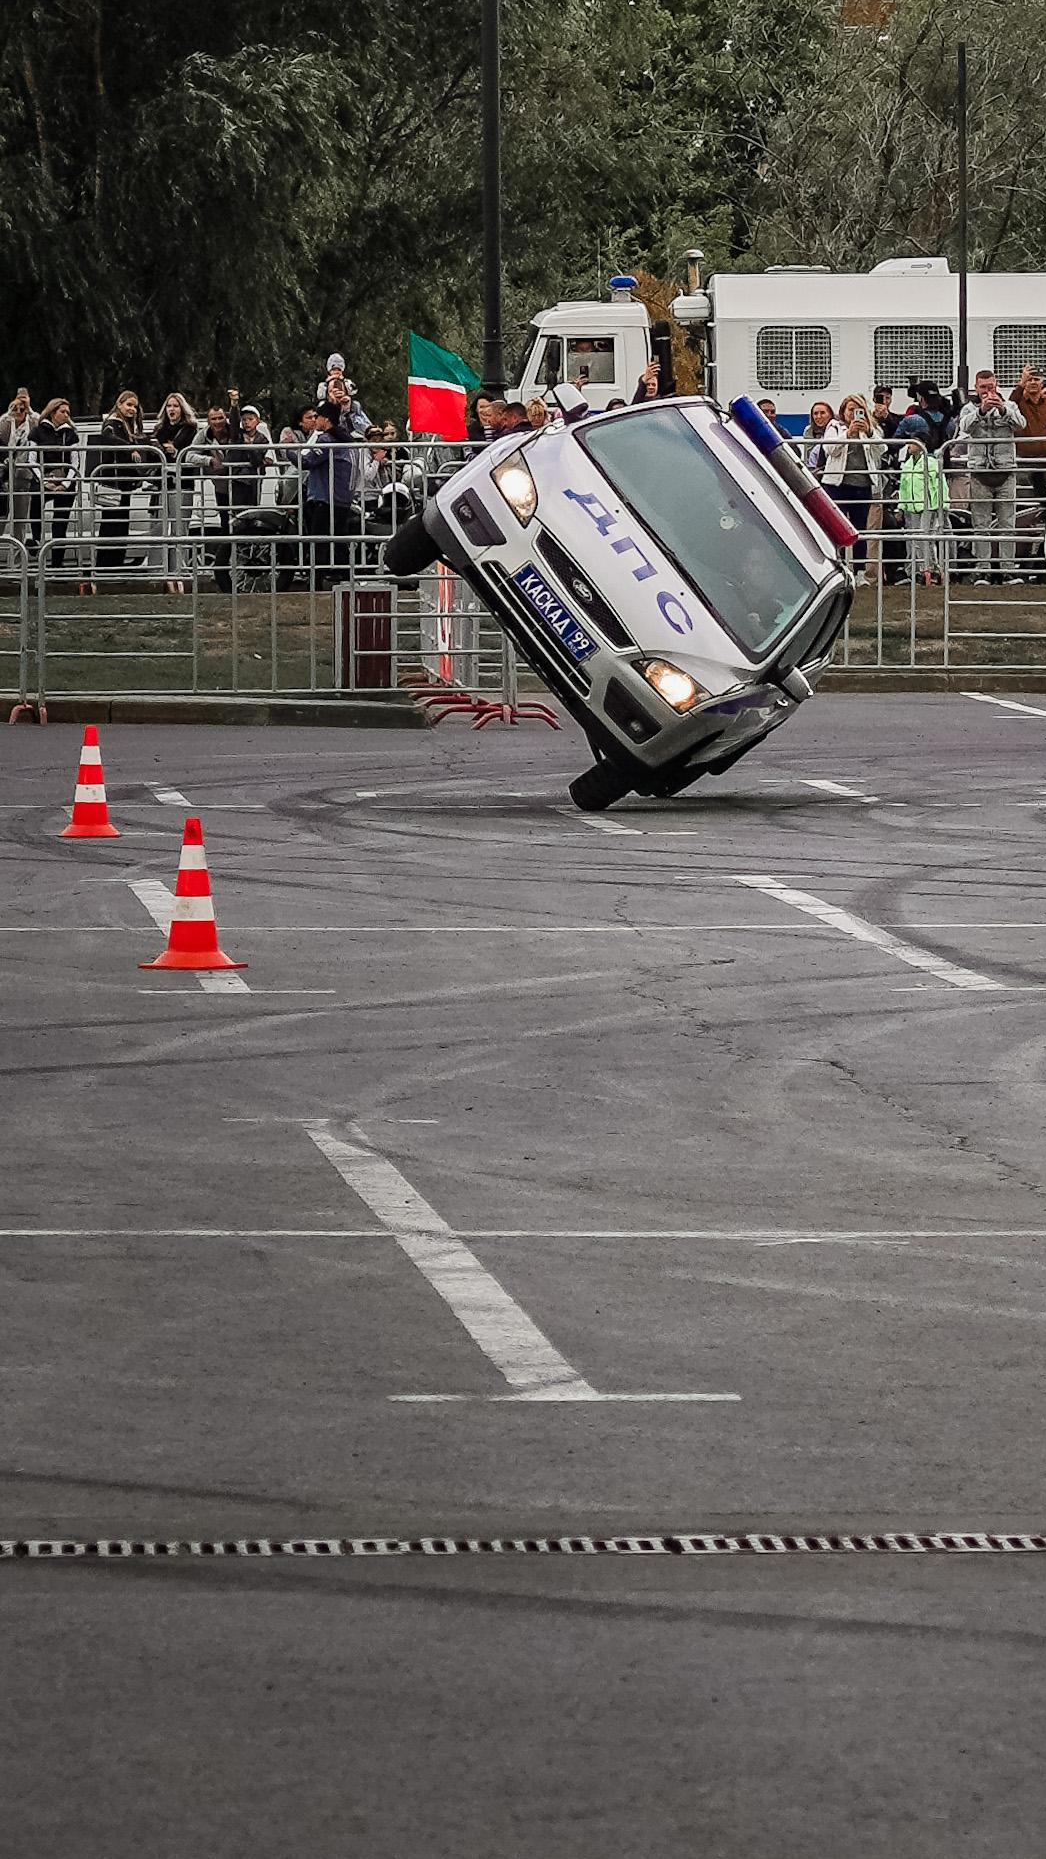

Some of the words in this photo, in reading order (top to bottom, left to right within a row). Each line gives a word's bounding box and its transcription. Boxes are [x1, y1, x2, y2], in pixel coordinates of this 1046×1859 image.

[520, 573, 571, 636] КАСКАД
[571, 631, 590, 650] 99
[562, 488, 694, 635] ДПС
